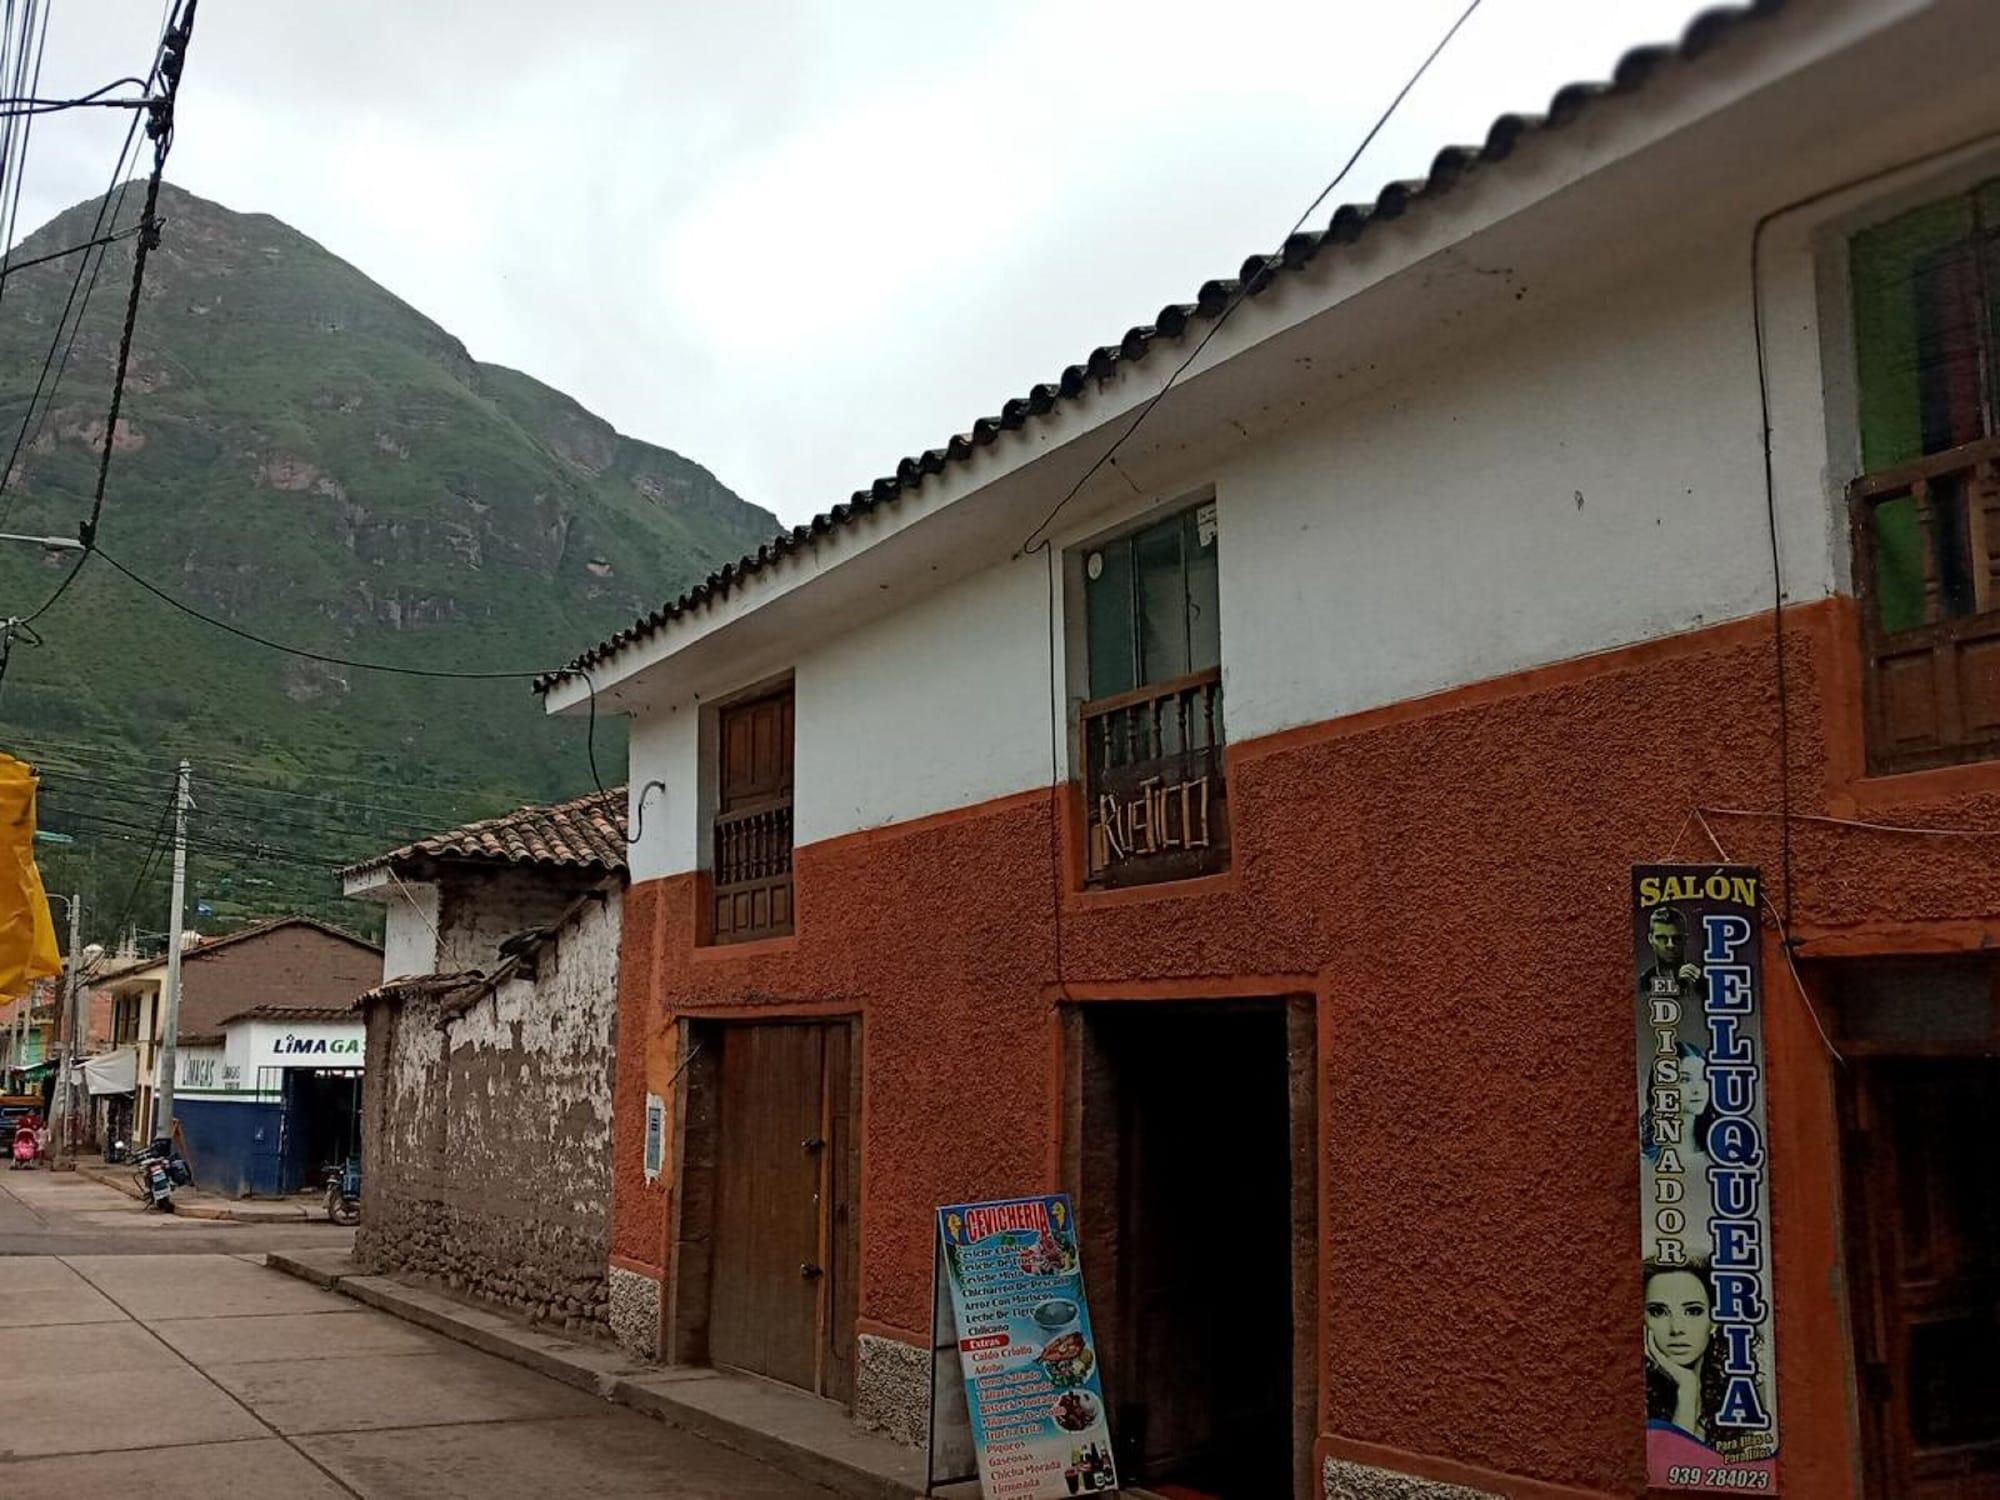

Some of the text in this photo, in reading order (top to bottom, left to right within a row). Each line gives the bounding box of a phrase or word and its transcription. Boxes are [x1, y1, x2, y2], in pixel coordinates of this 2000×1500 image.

[1639, 868, 1757, 908] SALÓN
[1653, 979, 1678, 993] EL
[1651, 1000, 1686, 1264] DISEÑADOR
[1703, 914, 1770, 1429] PELUQUERIA
[965, 1201, 1051, 1243] CEVICHERIA
[964, 1300, 991, 1311] Arroz
[992, 1298, 1011, 1307] Con
[966, 1311, 995, 1324] Leche
[996, 1310, 1010, 1319] De
[969, 1338, 1001, 1349] Extras
[972, 1351, 999, 1362] Caldo
[1668, 1467, 1769, 1489] 939 284023
